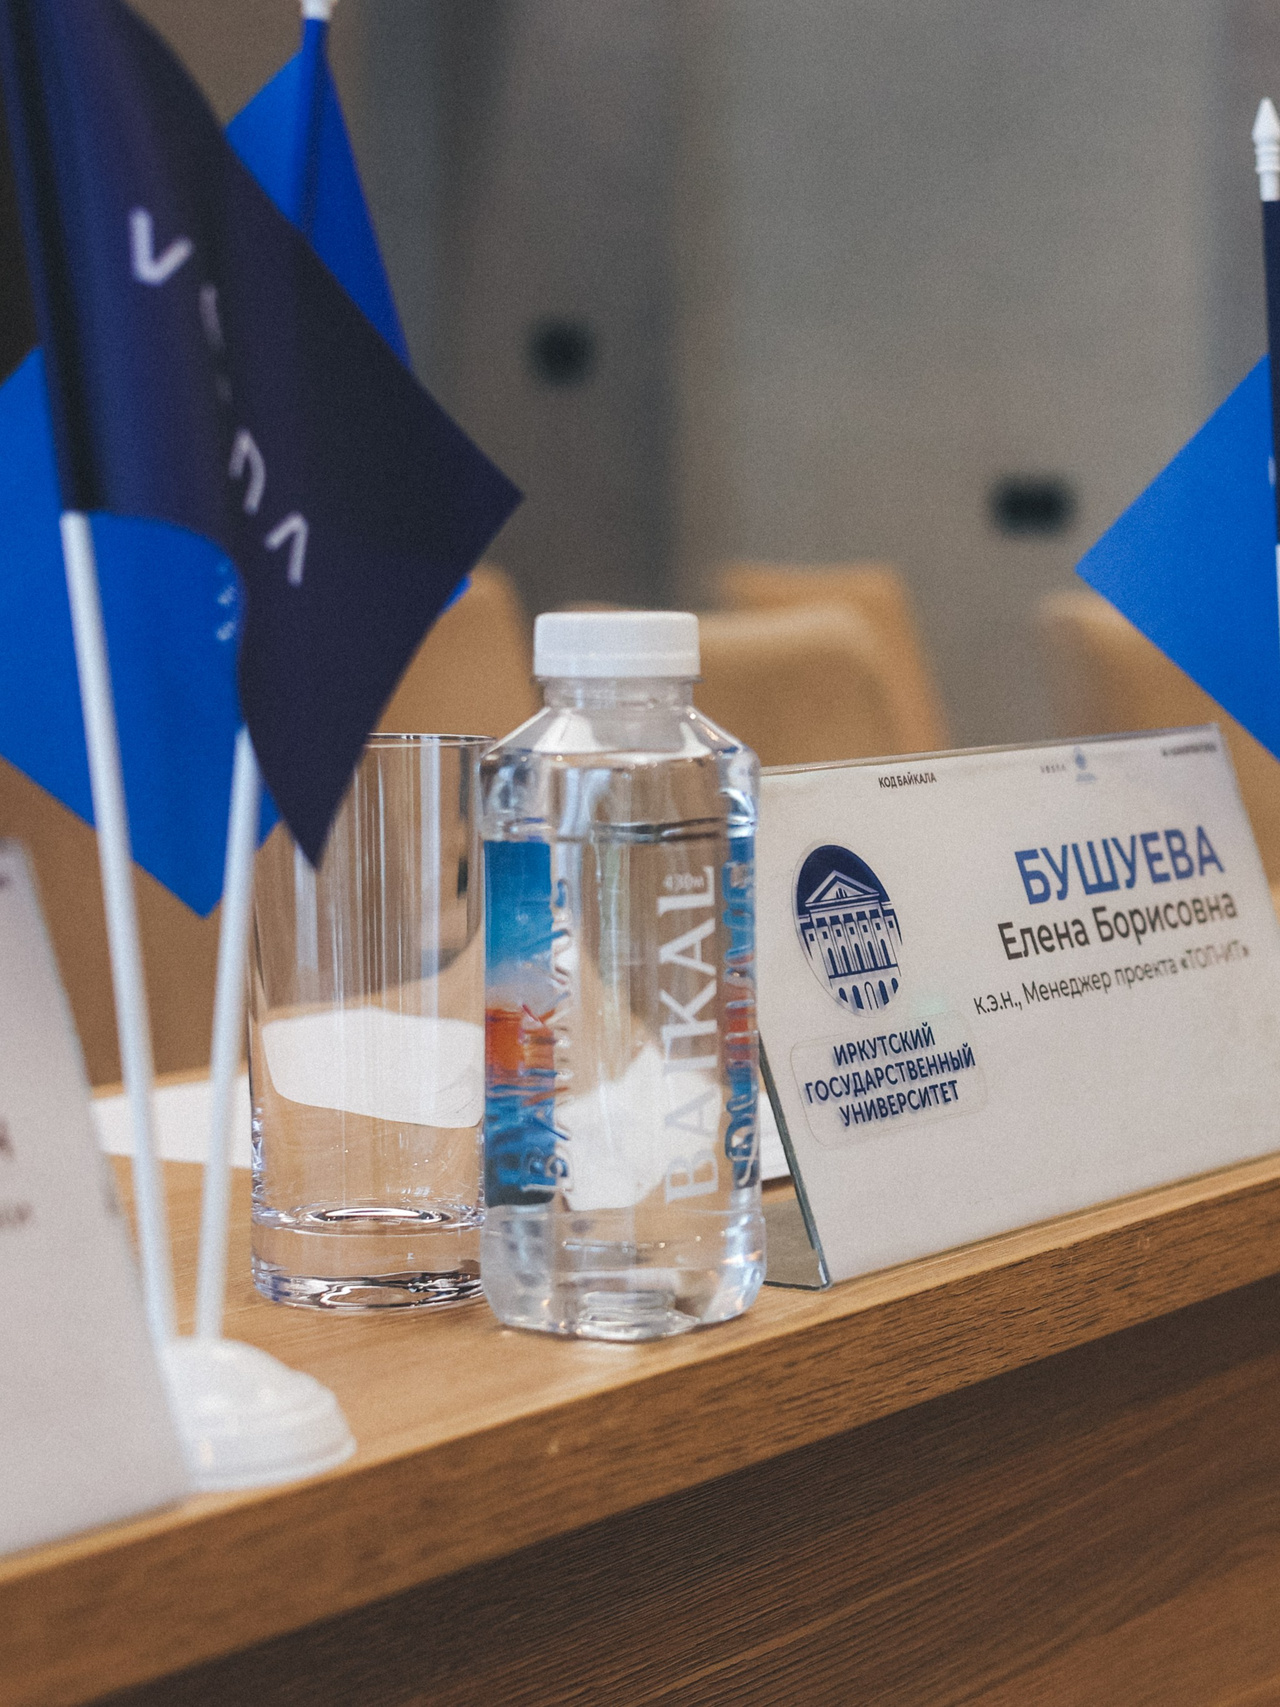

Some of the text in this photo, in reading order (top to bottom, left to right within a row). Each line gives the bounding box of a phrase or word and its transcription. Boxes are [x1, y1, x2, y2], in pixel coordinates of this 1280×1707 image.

[878, 771, 937, 789] КОД БАЙКАЛА
[1014, 825, 1226, 905] БУШУЕВА
[998, 892, 1239, 960] Елена Борисовна
[1022, 970, 1112, 1004] Менеджер
[1114, 958, 1179, 987] проекта
[657, 865, 720, 1204] BAIKAL
[833, 1021, 936, 1067] ИРКУТСКИЙ
[805, 1042, 977, 1104] ГОСУДАРСТВЕННЫЙ
[839, 1079, 960, 1127] УНИВЕРСИТЕТ
